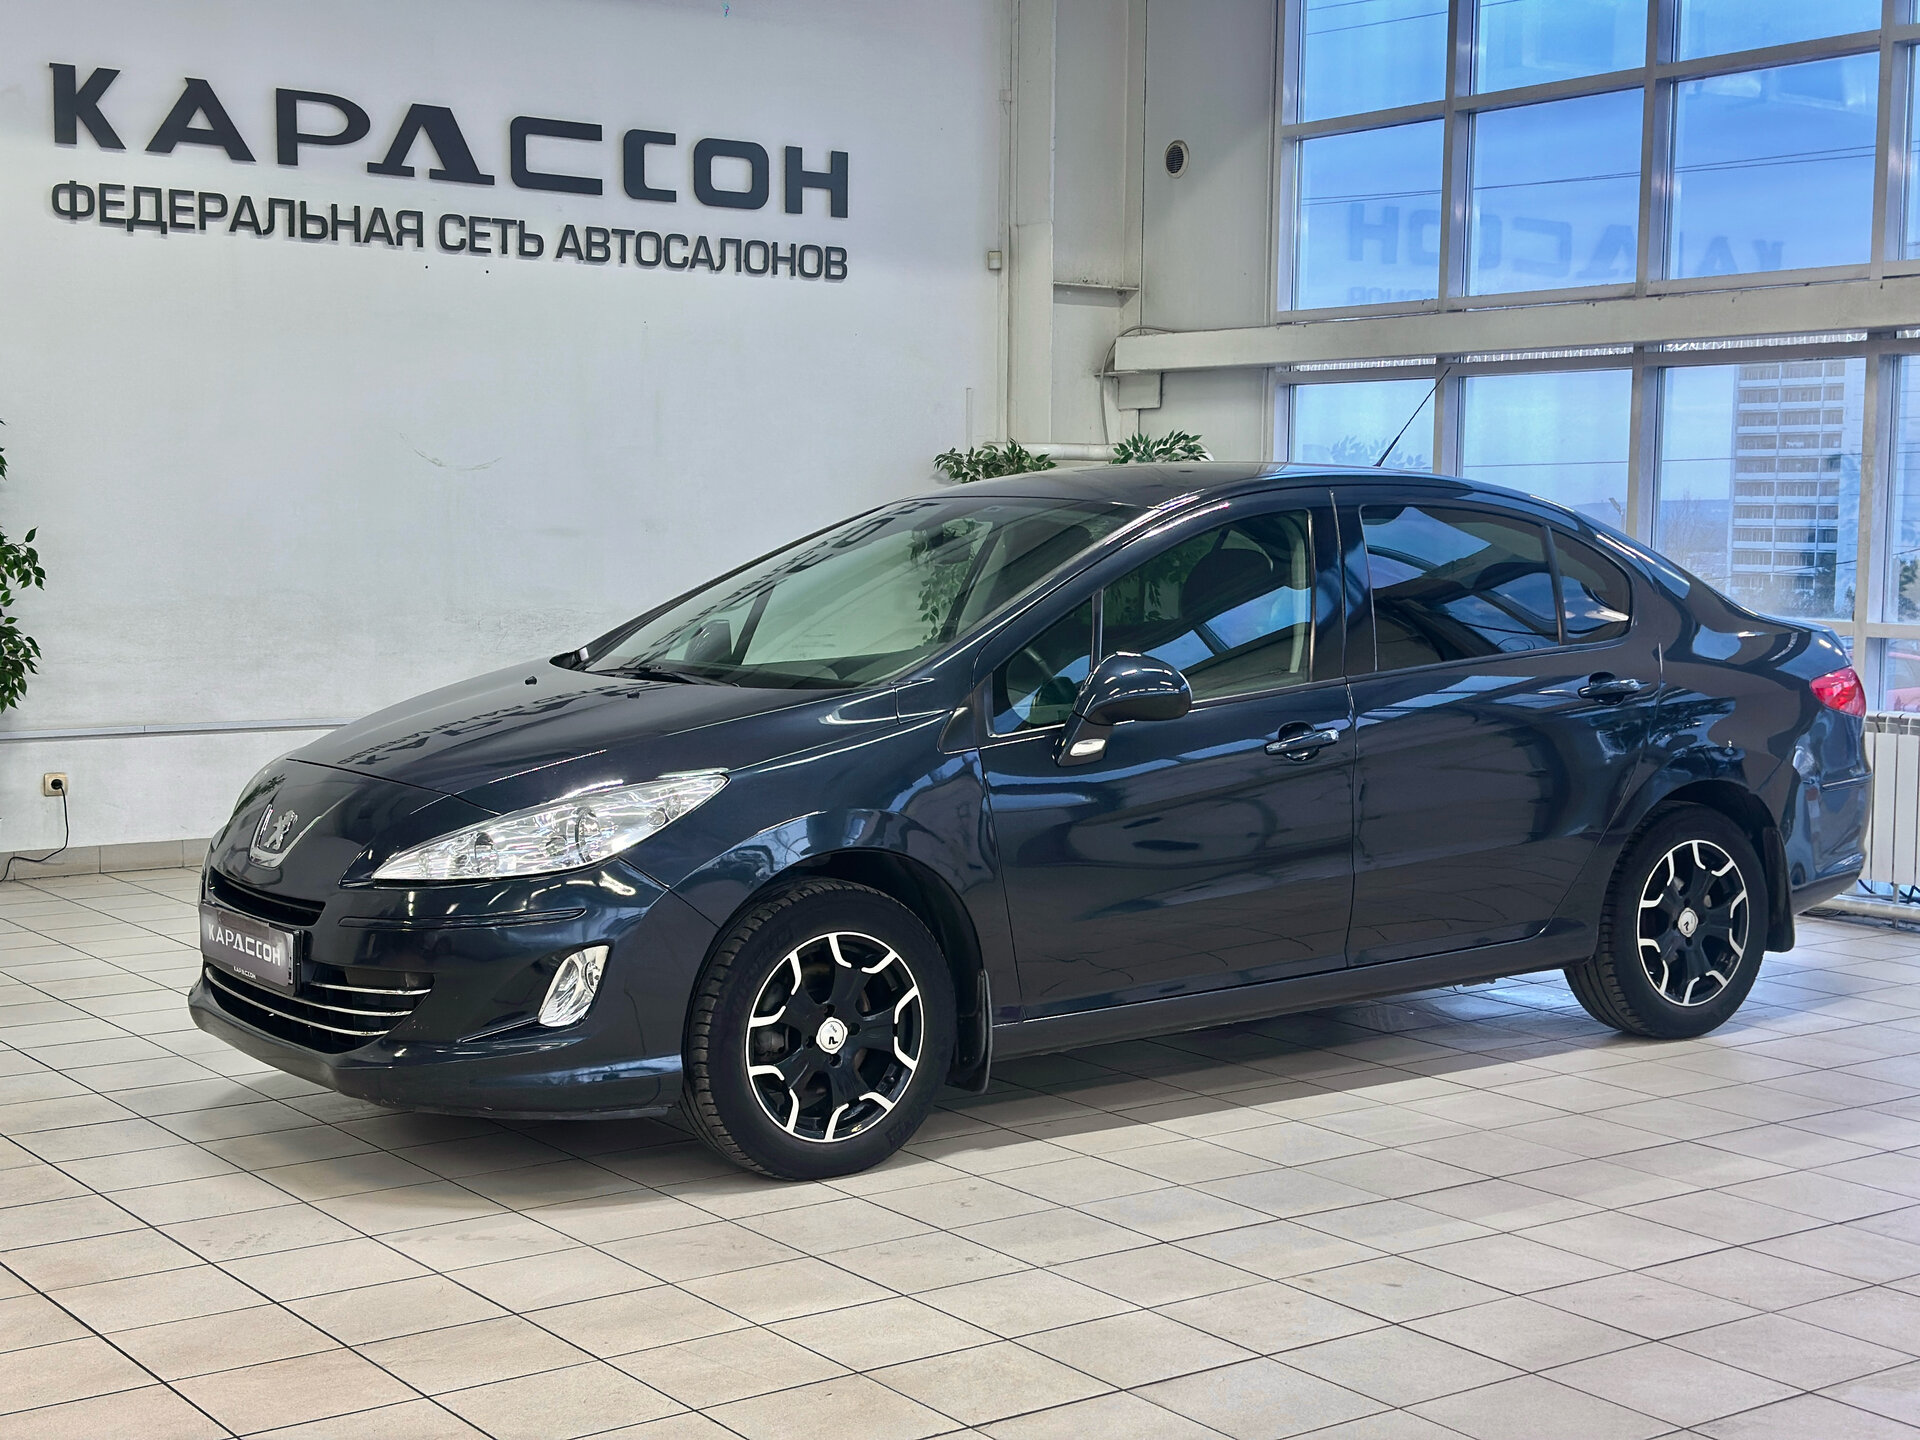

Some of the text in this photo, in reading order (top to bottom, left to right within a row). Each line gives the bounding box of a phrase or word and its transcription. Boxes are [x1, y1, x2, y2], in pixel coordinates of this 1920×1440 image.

[51, 180, 848, 281] ФЕДЕРАЛЬНАЯ СЕТЬ АВТОСАЛОНОВ
